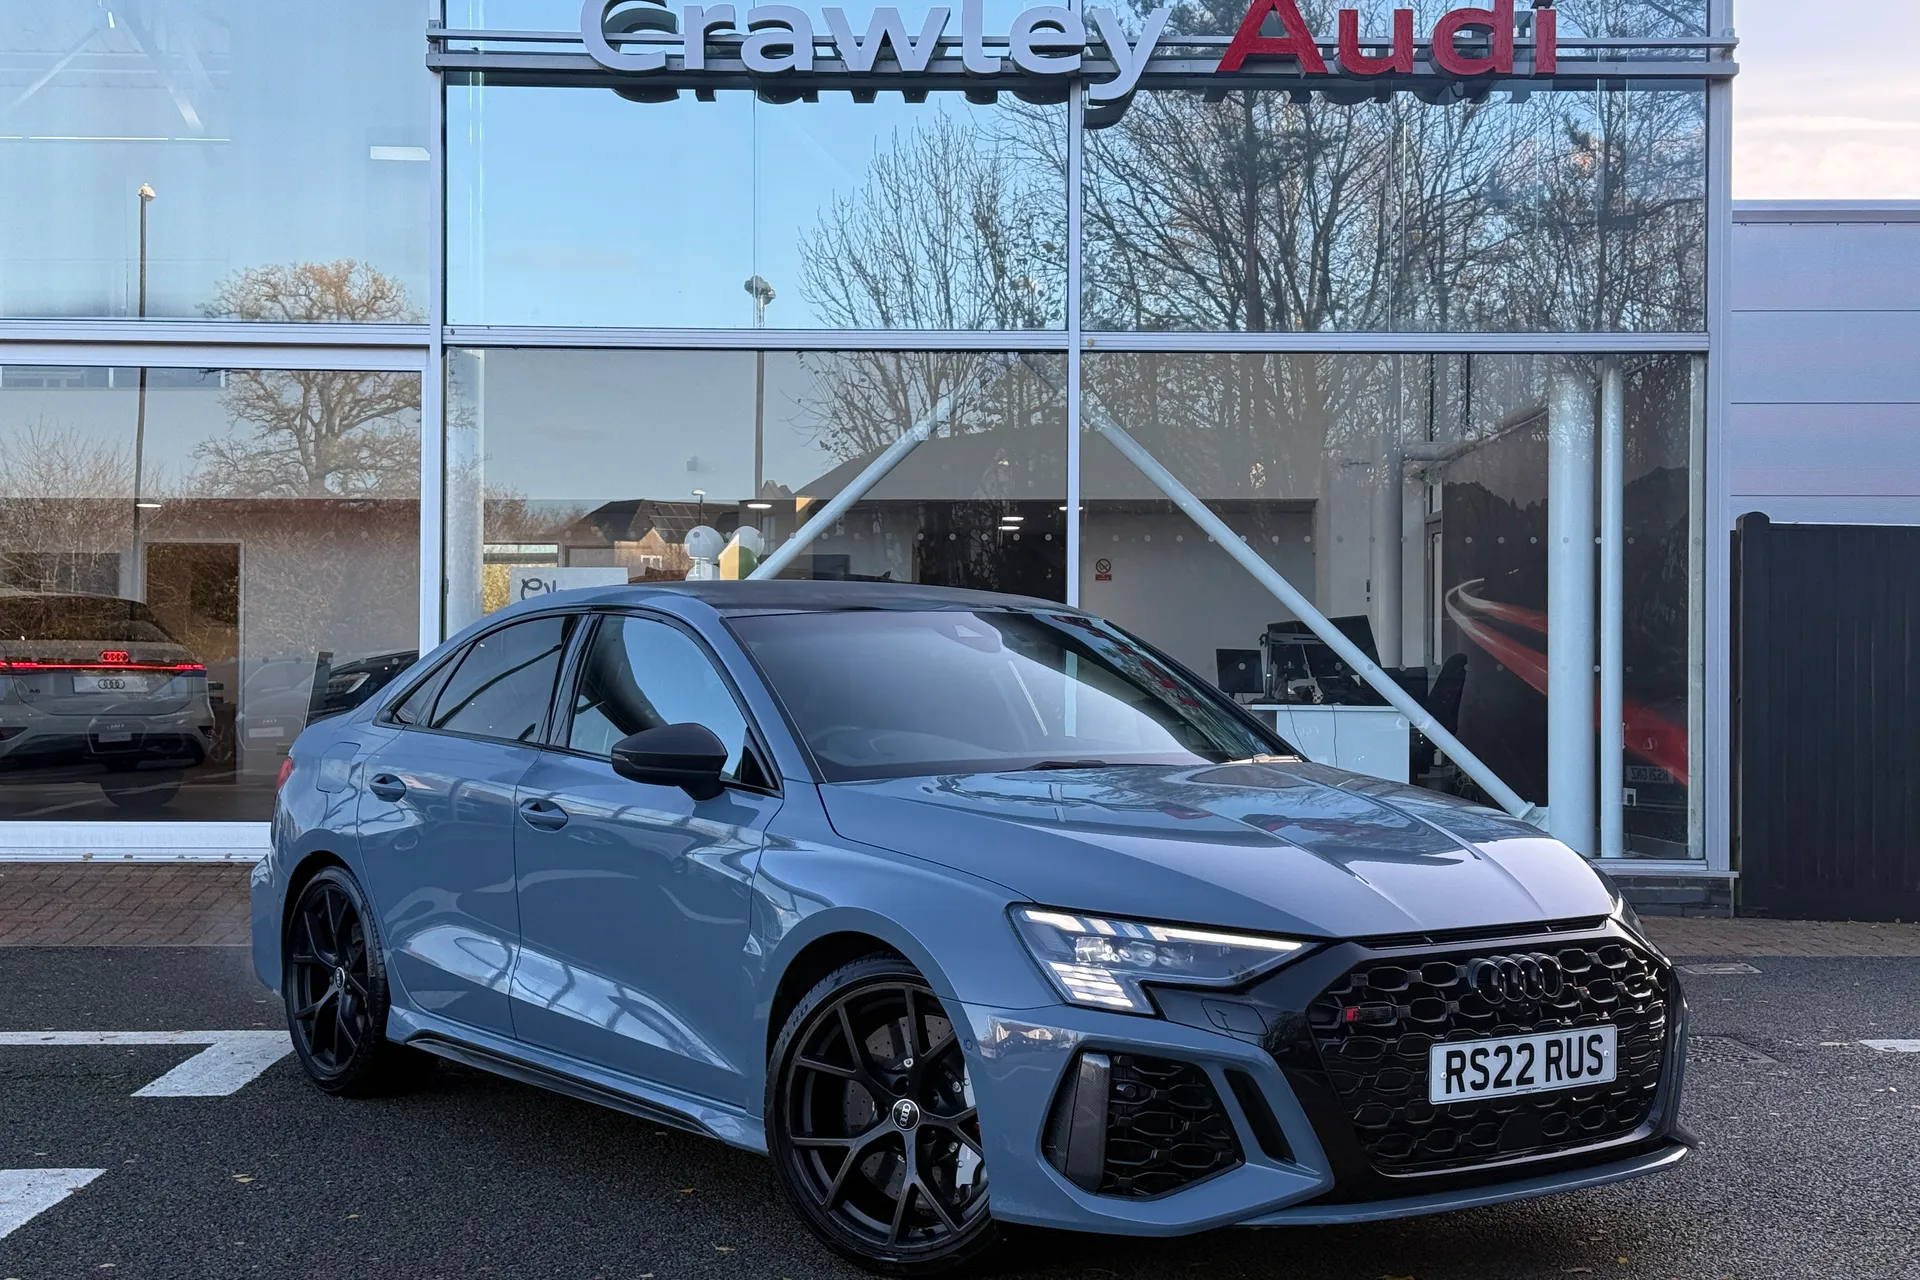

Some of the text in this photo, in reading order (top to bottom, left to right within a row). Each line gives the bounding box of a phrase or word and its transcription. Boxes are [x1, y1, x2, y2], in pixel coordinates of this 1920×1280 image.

[580, 0, 1556, 99] Crawley Audi
[1446, 1034, 1604, 1094] RS22 RUS
